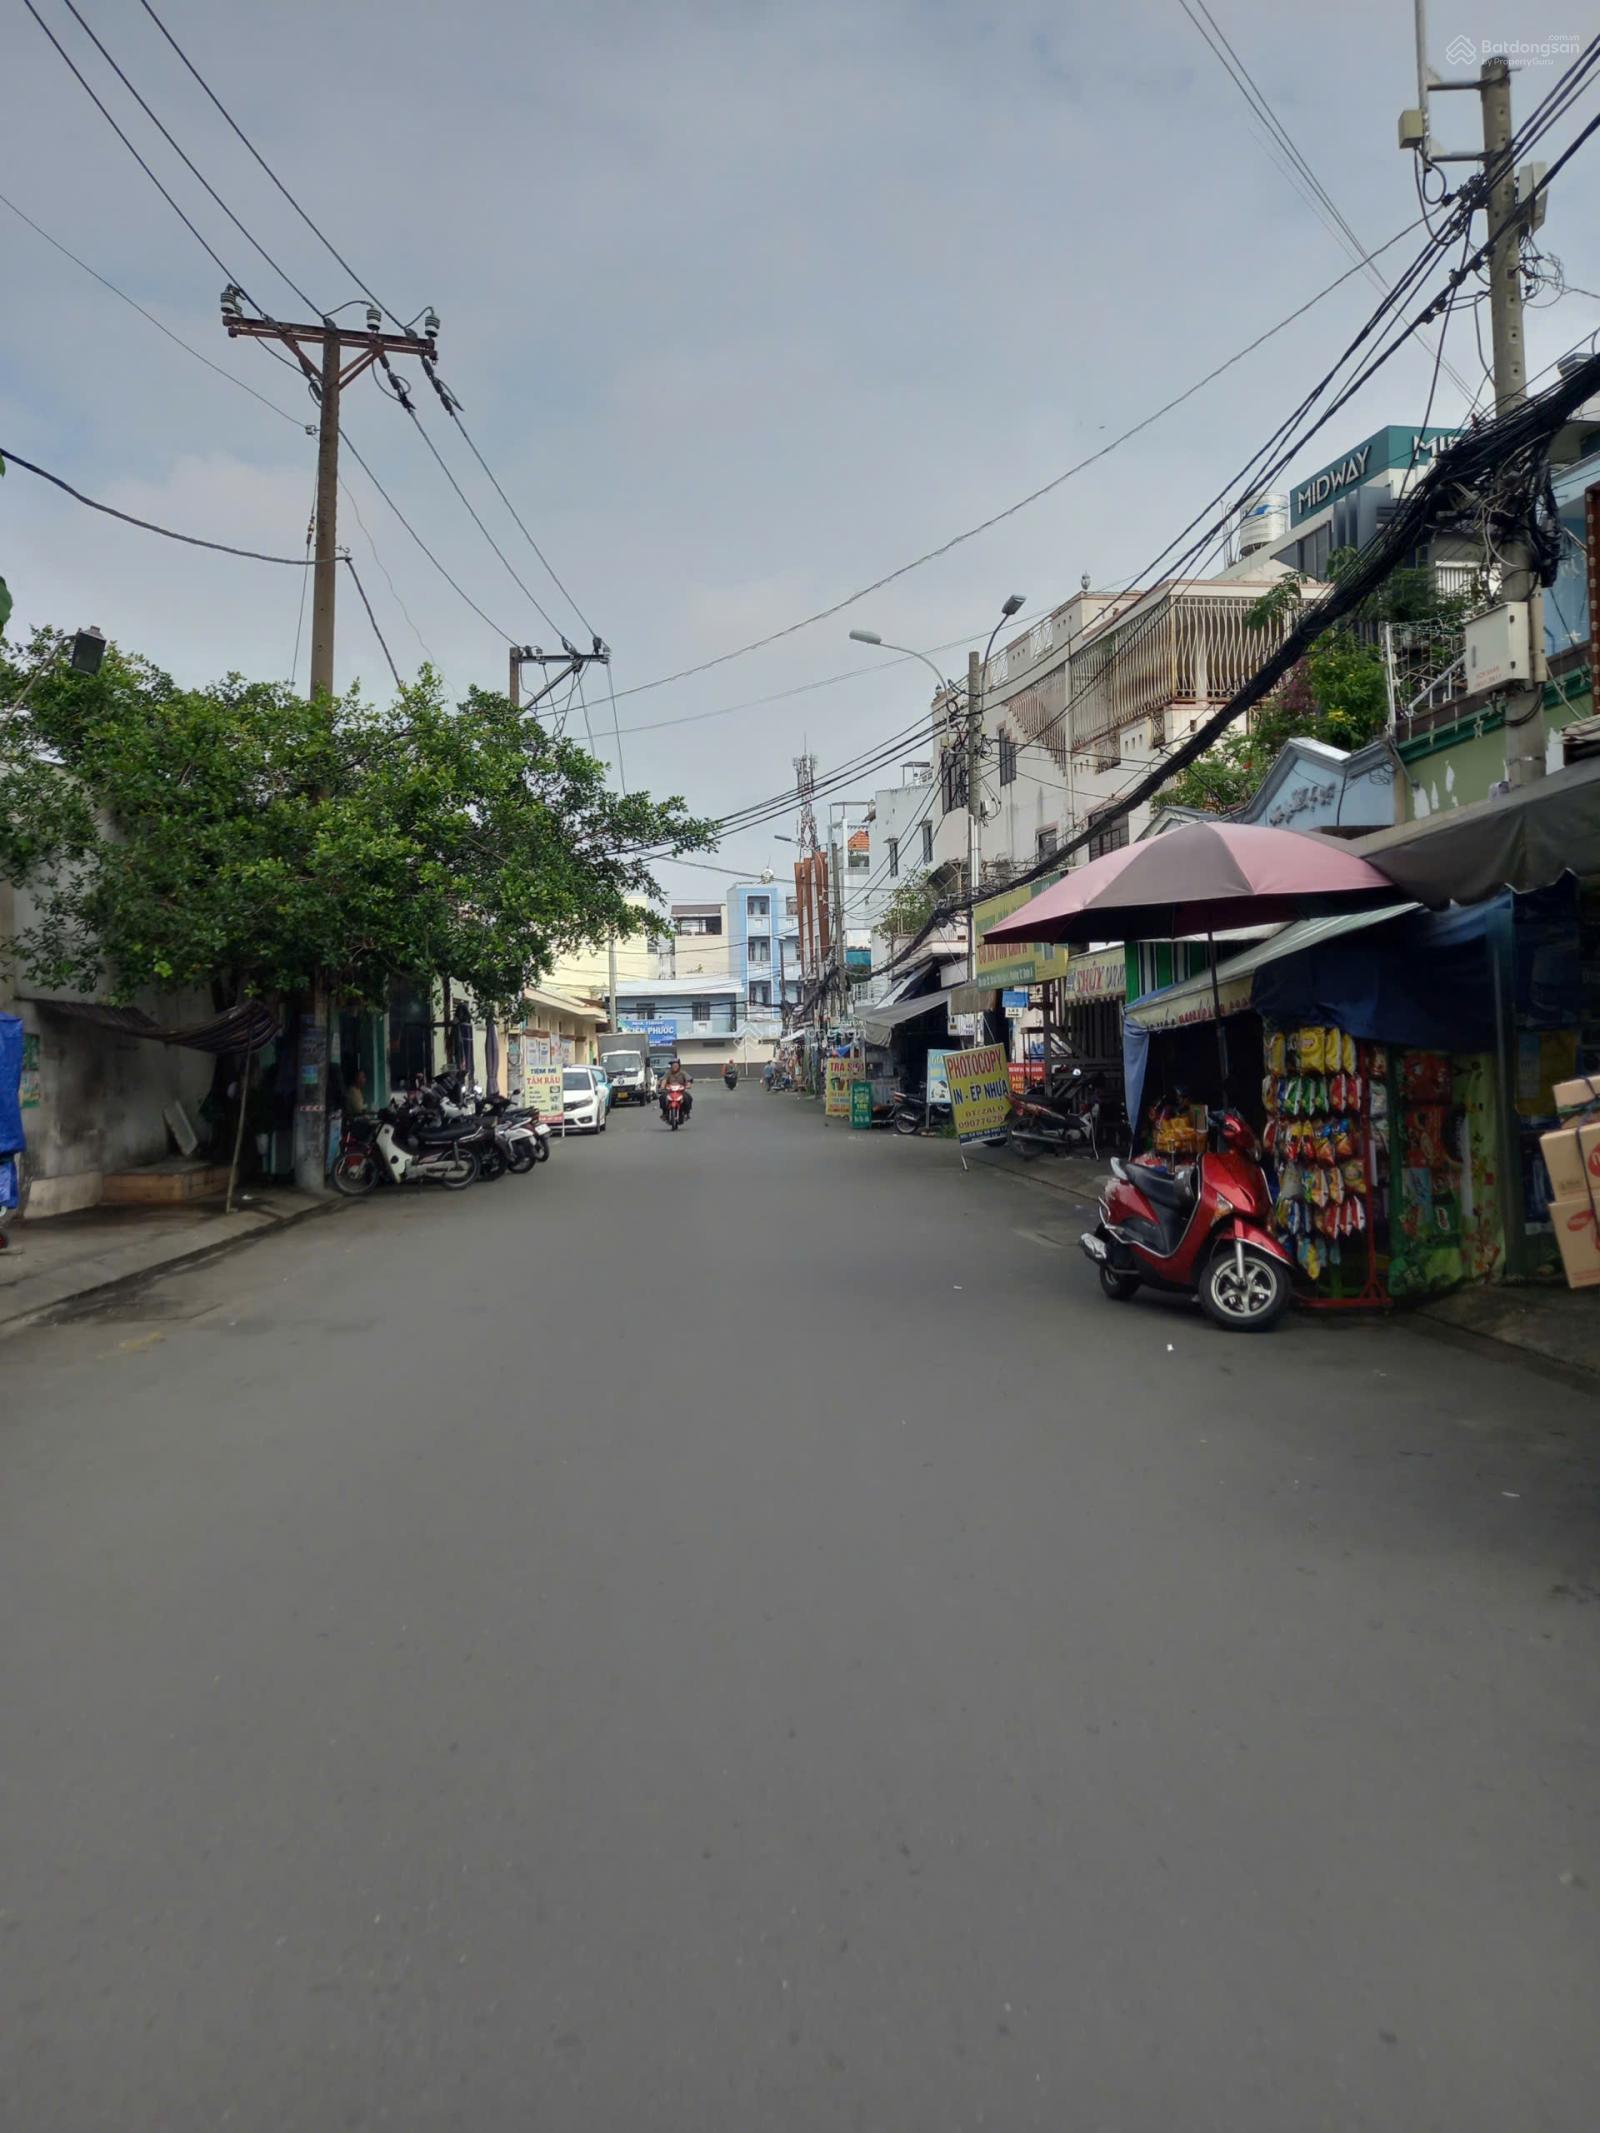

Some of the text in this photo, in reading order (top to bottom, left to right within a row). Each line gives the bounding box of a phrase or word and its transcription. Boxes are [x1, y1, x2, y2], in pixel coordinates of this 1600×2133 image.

[1298, 445, 1372, 514] MIDWAY
[947, 1047, 1003, 1078] PHOTOCOPY
[953, 1088, 963, 1105] IN
